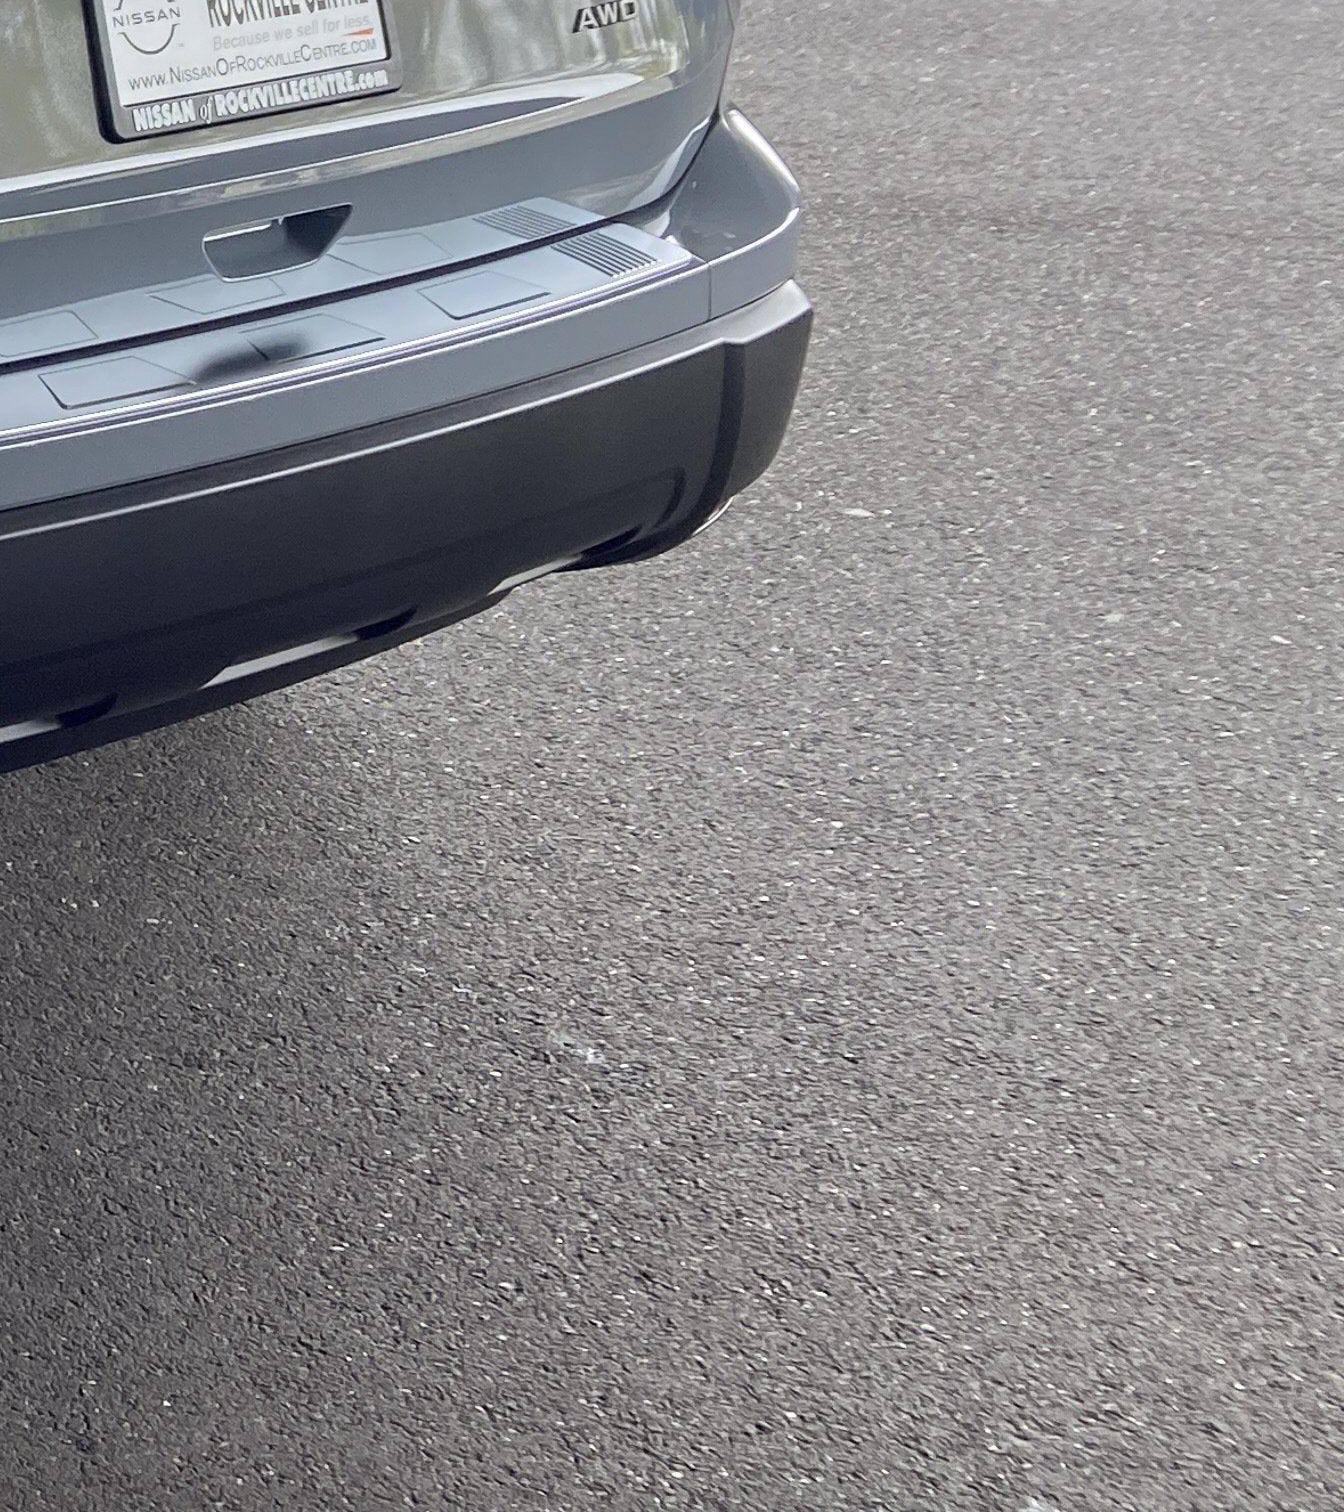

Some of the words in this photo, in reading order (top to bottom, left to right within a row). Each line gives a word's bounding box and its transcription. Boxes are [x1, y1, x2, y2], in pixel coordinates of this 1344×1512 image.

[111, 6, 182, 28] NISSAN
[211, 31, 270, 52] Because
[273, 27, 293, 40] we
[296, 20, 319, 38] sell
[321, 16, 341, 34] for
[342, 13, 371, 31] less
[131, 98, 196, 132] NISSAN
[198, 96, 213, 125] of
[214, 69, 390, 117] ROCKVILLECENTRE.com
